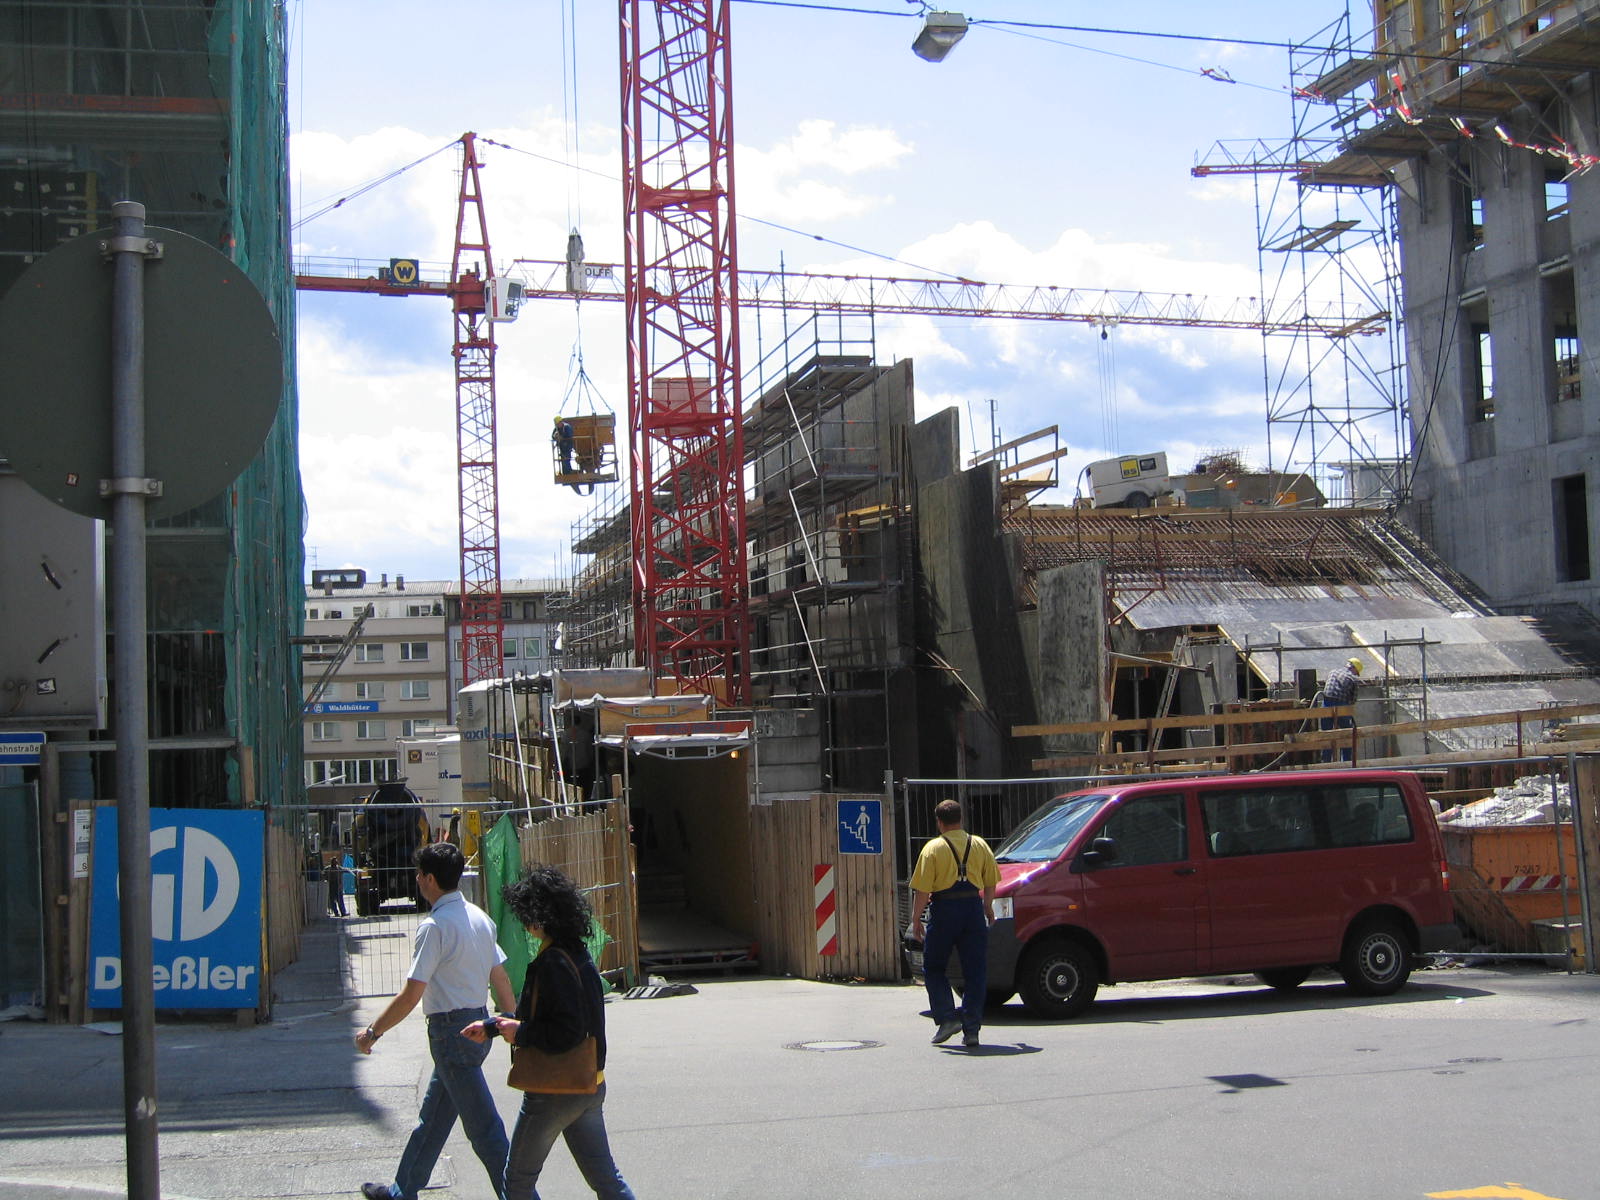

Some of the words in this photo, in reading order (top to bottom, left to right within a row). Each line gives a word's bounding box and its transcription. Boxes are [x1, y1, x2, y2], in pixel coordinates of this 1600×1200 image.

[585, 267, 611, 277] OLFF
[0, 744, 40, 753] hnstraße
[94, 956, 255, 990] Deßler
